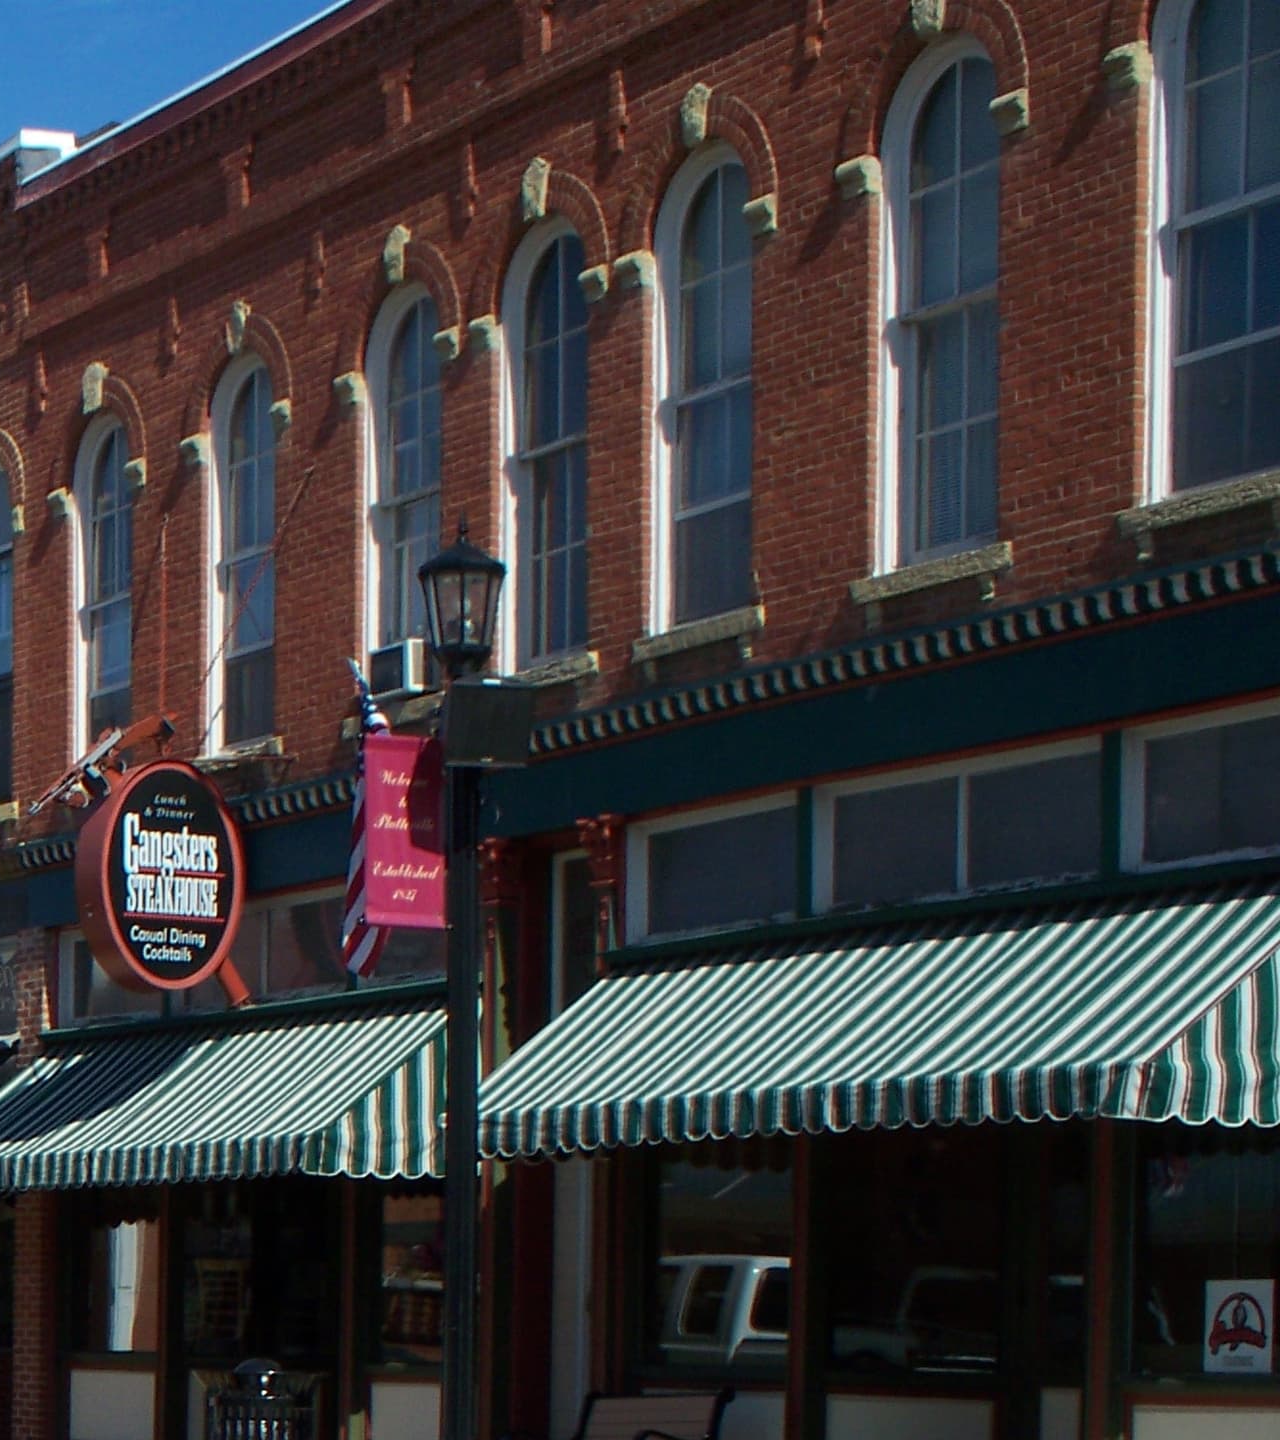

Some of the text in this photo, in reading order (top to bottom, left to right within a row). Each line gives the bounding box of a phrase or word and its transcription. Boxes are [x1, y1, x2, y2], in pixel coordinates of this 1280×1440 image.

[153, 793, 187, 806] Lunch
[155, 807, 195, 820] Dinner
[123, 812, 219, 880] Gangsters
[372, 860, 440, 881] Established
[126, 874, 219, 918] STEAKHOUSE
[129, 924, 207, 949] Casual Dining
[142, 944, 192, 962] Cocktails
